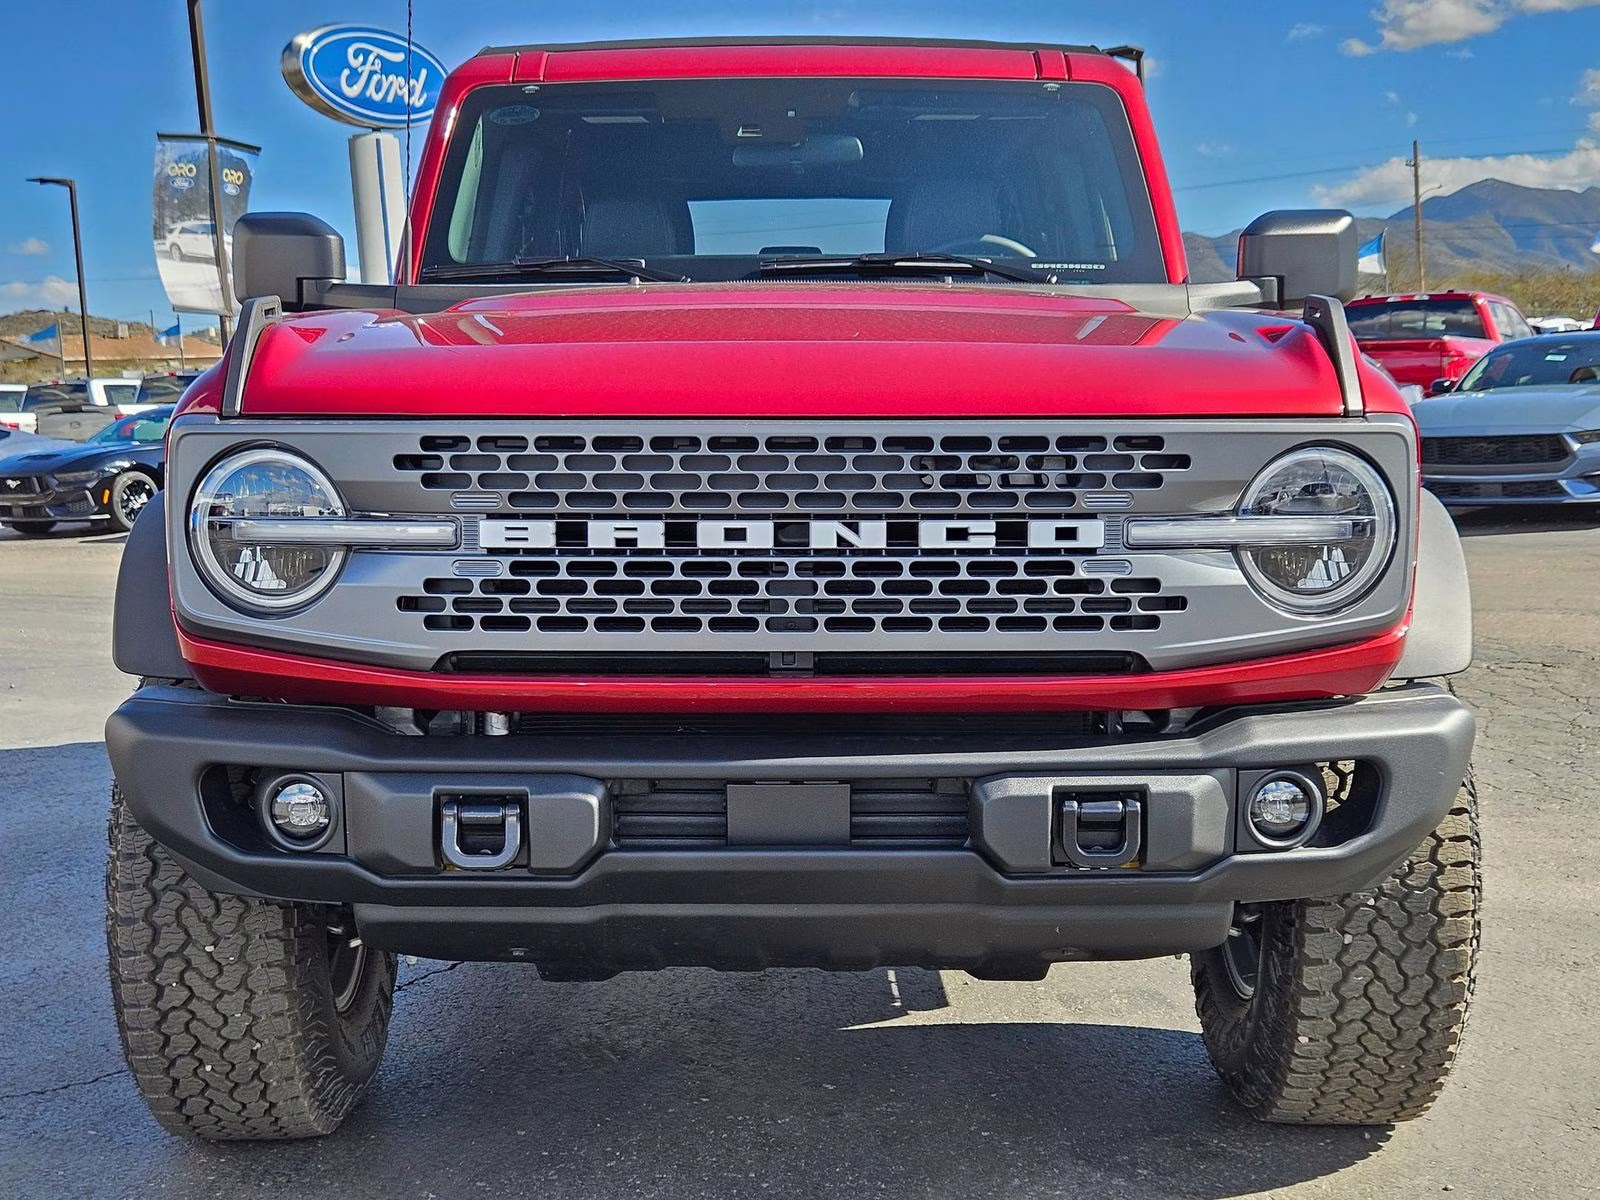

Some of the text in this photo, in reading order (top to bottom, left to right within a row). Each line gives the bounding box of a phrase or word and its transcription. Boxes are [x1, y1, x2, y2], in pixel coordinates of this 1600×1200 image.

[340, 42, 428, 108] Ford
[168, 162, 197, 177] ORO
[223, 168, 243, 184] ORO
[479, 519, 1105, 549] BRONCO
